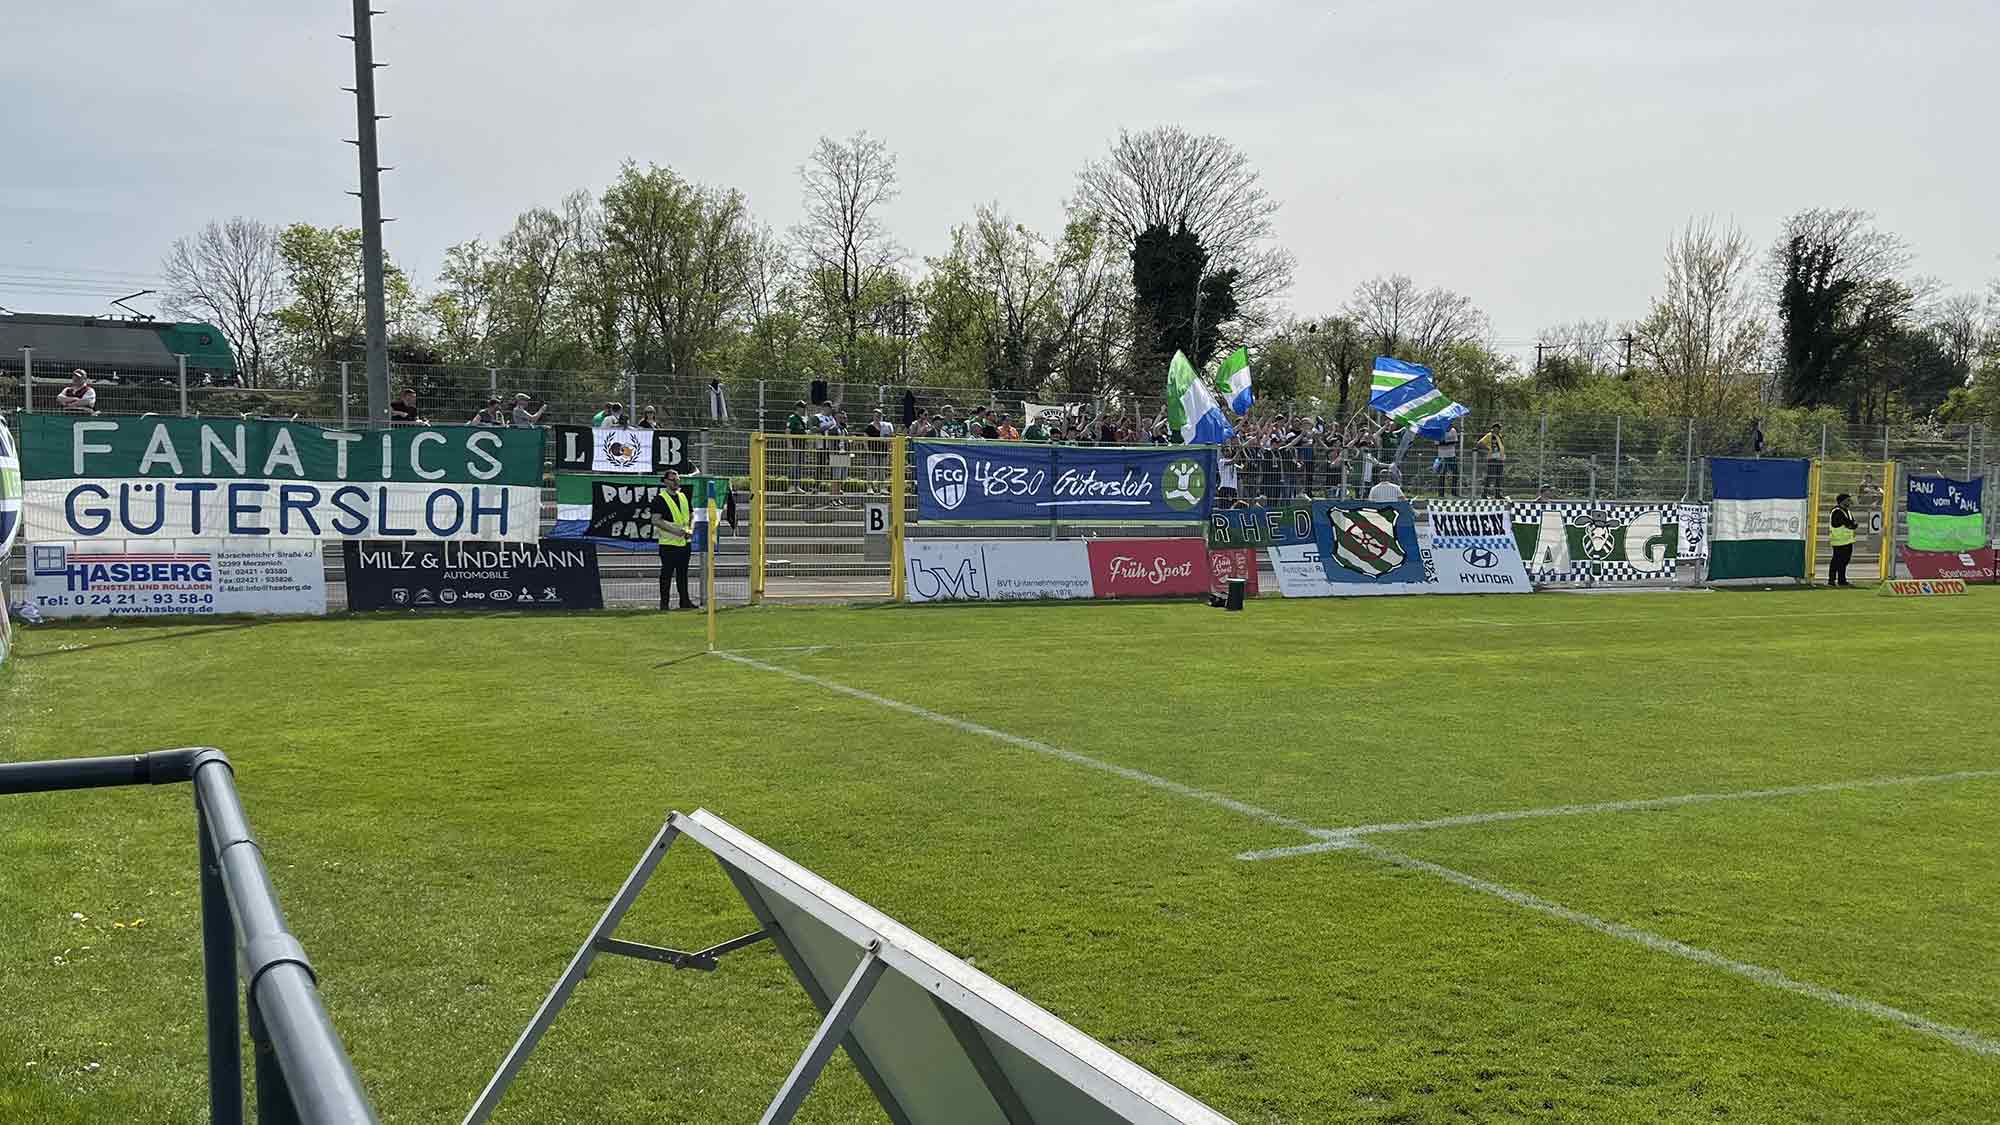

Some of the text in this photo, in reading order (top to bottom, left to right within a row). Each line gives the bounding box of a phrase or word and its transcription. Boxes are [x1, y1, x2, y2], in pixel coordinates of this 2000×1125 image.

[73, 422, 502, 479] FANATICS
[564, 432, 585, 463] L
[658, 436, 682, 466] B
[935, 469, 963, 482] FCG
[975, 461, 1153, 496] 4830 Gütersloh
[1910, 480, 1934, 494] FANS
[65, 483, 508, 536] GÜTERSLOH
[871, 508, 884, 531] B
[1432, 513, 1506, 537] MINDEN
[1871, 514, 1881, 531] C
[1531, 511, 1668, 575] A G
[359, 551, 585, 569] MILZ & LINDEMANN
[1110, 556, 1192, 584] Früh Sport
[67, 564, 212, 591] HASBERG
[443, 570, 510, 579] AUTOMOBILE
[911, 558, 980, 598] bvt
[1460, 573, 1514, 585] HYUNDAI
[91, 584, 136, 592] FENSTER
[162, 583, 213, 591] ROLLADEN
[462, 590, 486, 600] Jeep
[1930, 582, 1964, 594] LOTTO
[37, 595, 69, 606] Tel:
[74, 594, 84, 605] 0
[91, 594, 111, 605] 24
[117, 594, 136, 605] 21
[153, 593, 173, 604] 93
[110, 605, 214, 615] www.hasberg.de
